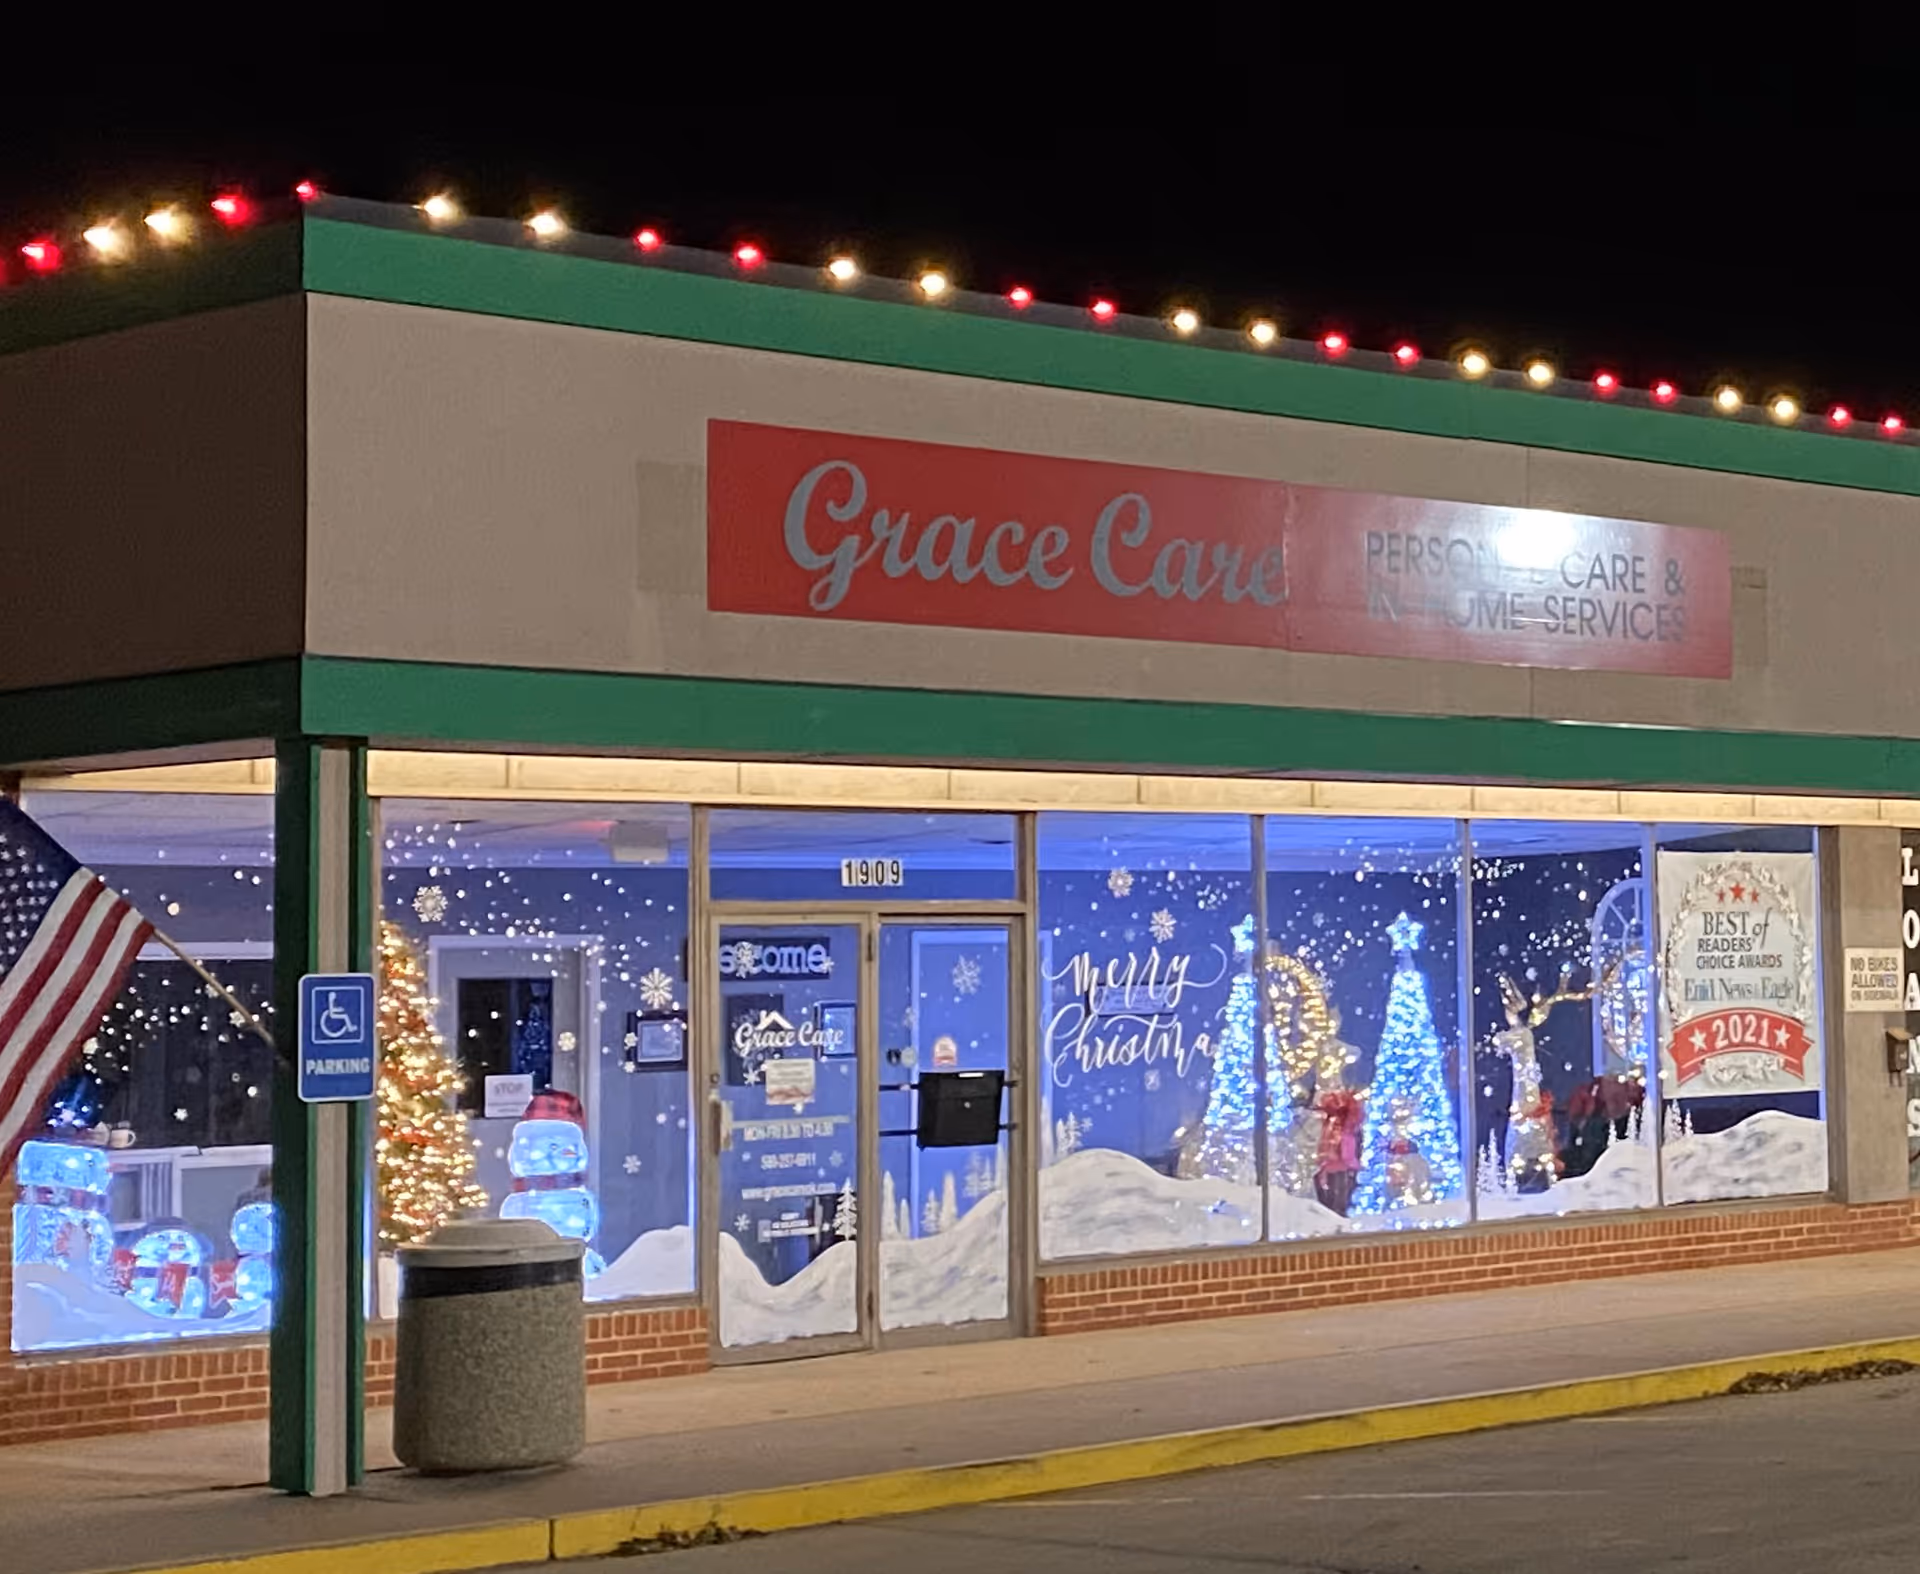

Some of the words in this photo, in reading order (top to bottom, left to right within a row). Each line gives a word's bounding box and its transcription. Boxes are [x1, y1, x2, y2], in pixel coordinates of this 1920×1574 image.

[784, 460, 1075, 611] Grace
[1091, 493, 1288, 606] Care
[1560, 552, 1646, 593] CARE
[1663, 557, 1685, 596] &
[1543, 594, 1686, 641] SERVICES
[845, 860, 900, 885] 1909
[1702, 911, 1749, 936] BEST
[1752, 907, 1773, 949] of
[1696, 955, 1735, 970] CHOICE
[1737, 954, 1783, 968] AWARDS
[1850, 956, 1865, 972] NO
[1868, 956, 1898, 972] BIKES
[1851, 973, 1899, 988] ALLOWED
[735, 1022, 796, 1057] Grace
[798, 1021, 844, 1046] Care
[1040, 1002, 1221, 1088] Christma
[1712, 1013, 1771, 1050] 2021
[305, 1057, 370, 1076] PARKING
